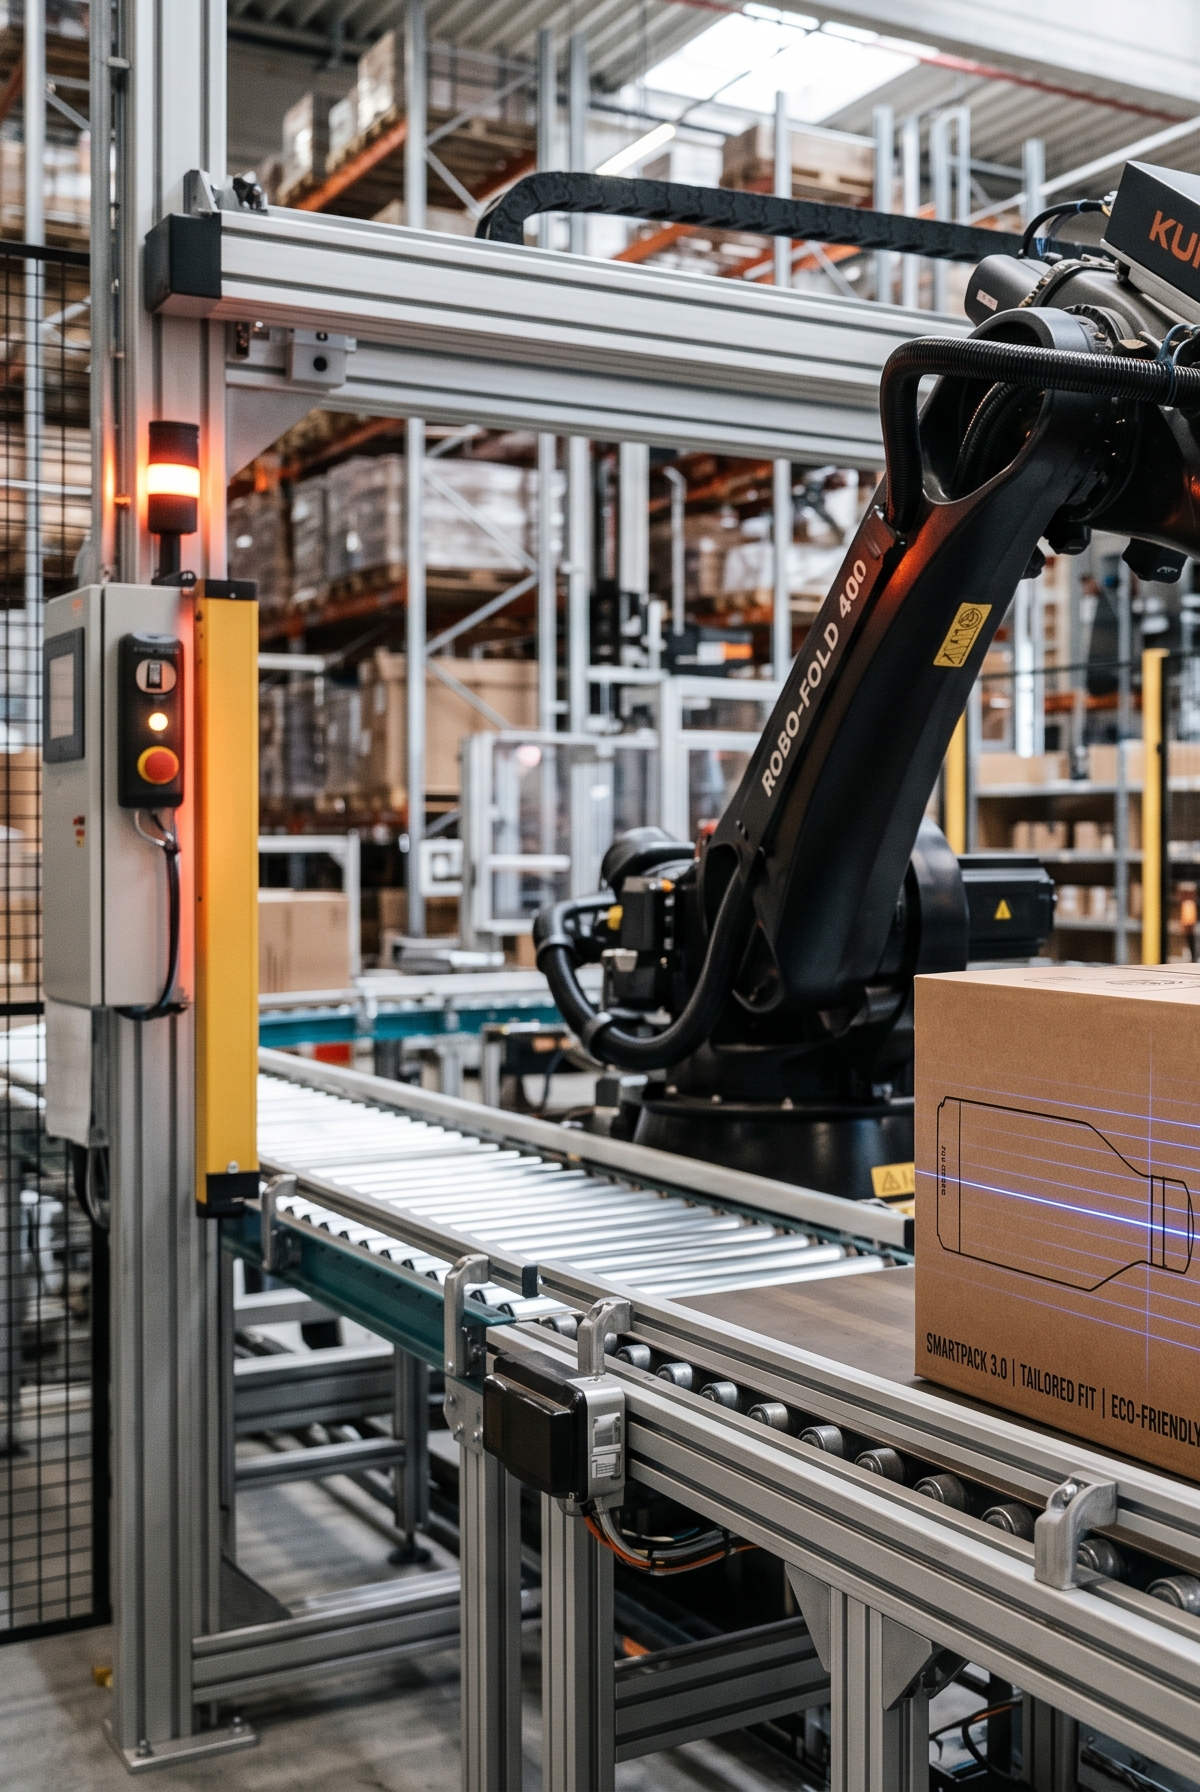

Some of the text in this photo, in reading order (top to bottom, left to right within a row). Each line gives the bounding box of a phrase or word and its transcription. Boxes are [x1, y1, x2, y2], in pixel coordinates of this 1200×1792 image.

[761, 559, 867, 797] ROBO-FOLD 400
[926, 1332, 988, 1374] SMARTPACK
[990, 1353, 1007, 1380] 3.0
[1020, 1363, 1075, 1403] TAILORED
[1078, 1382, 1097, 1411] FIT
